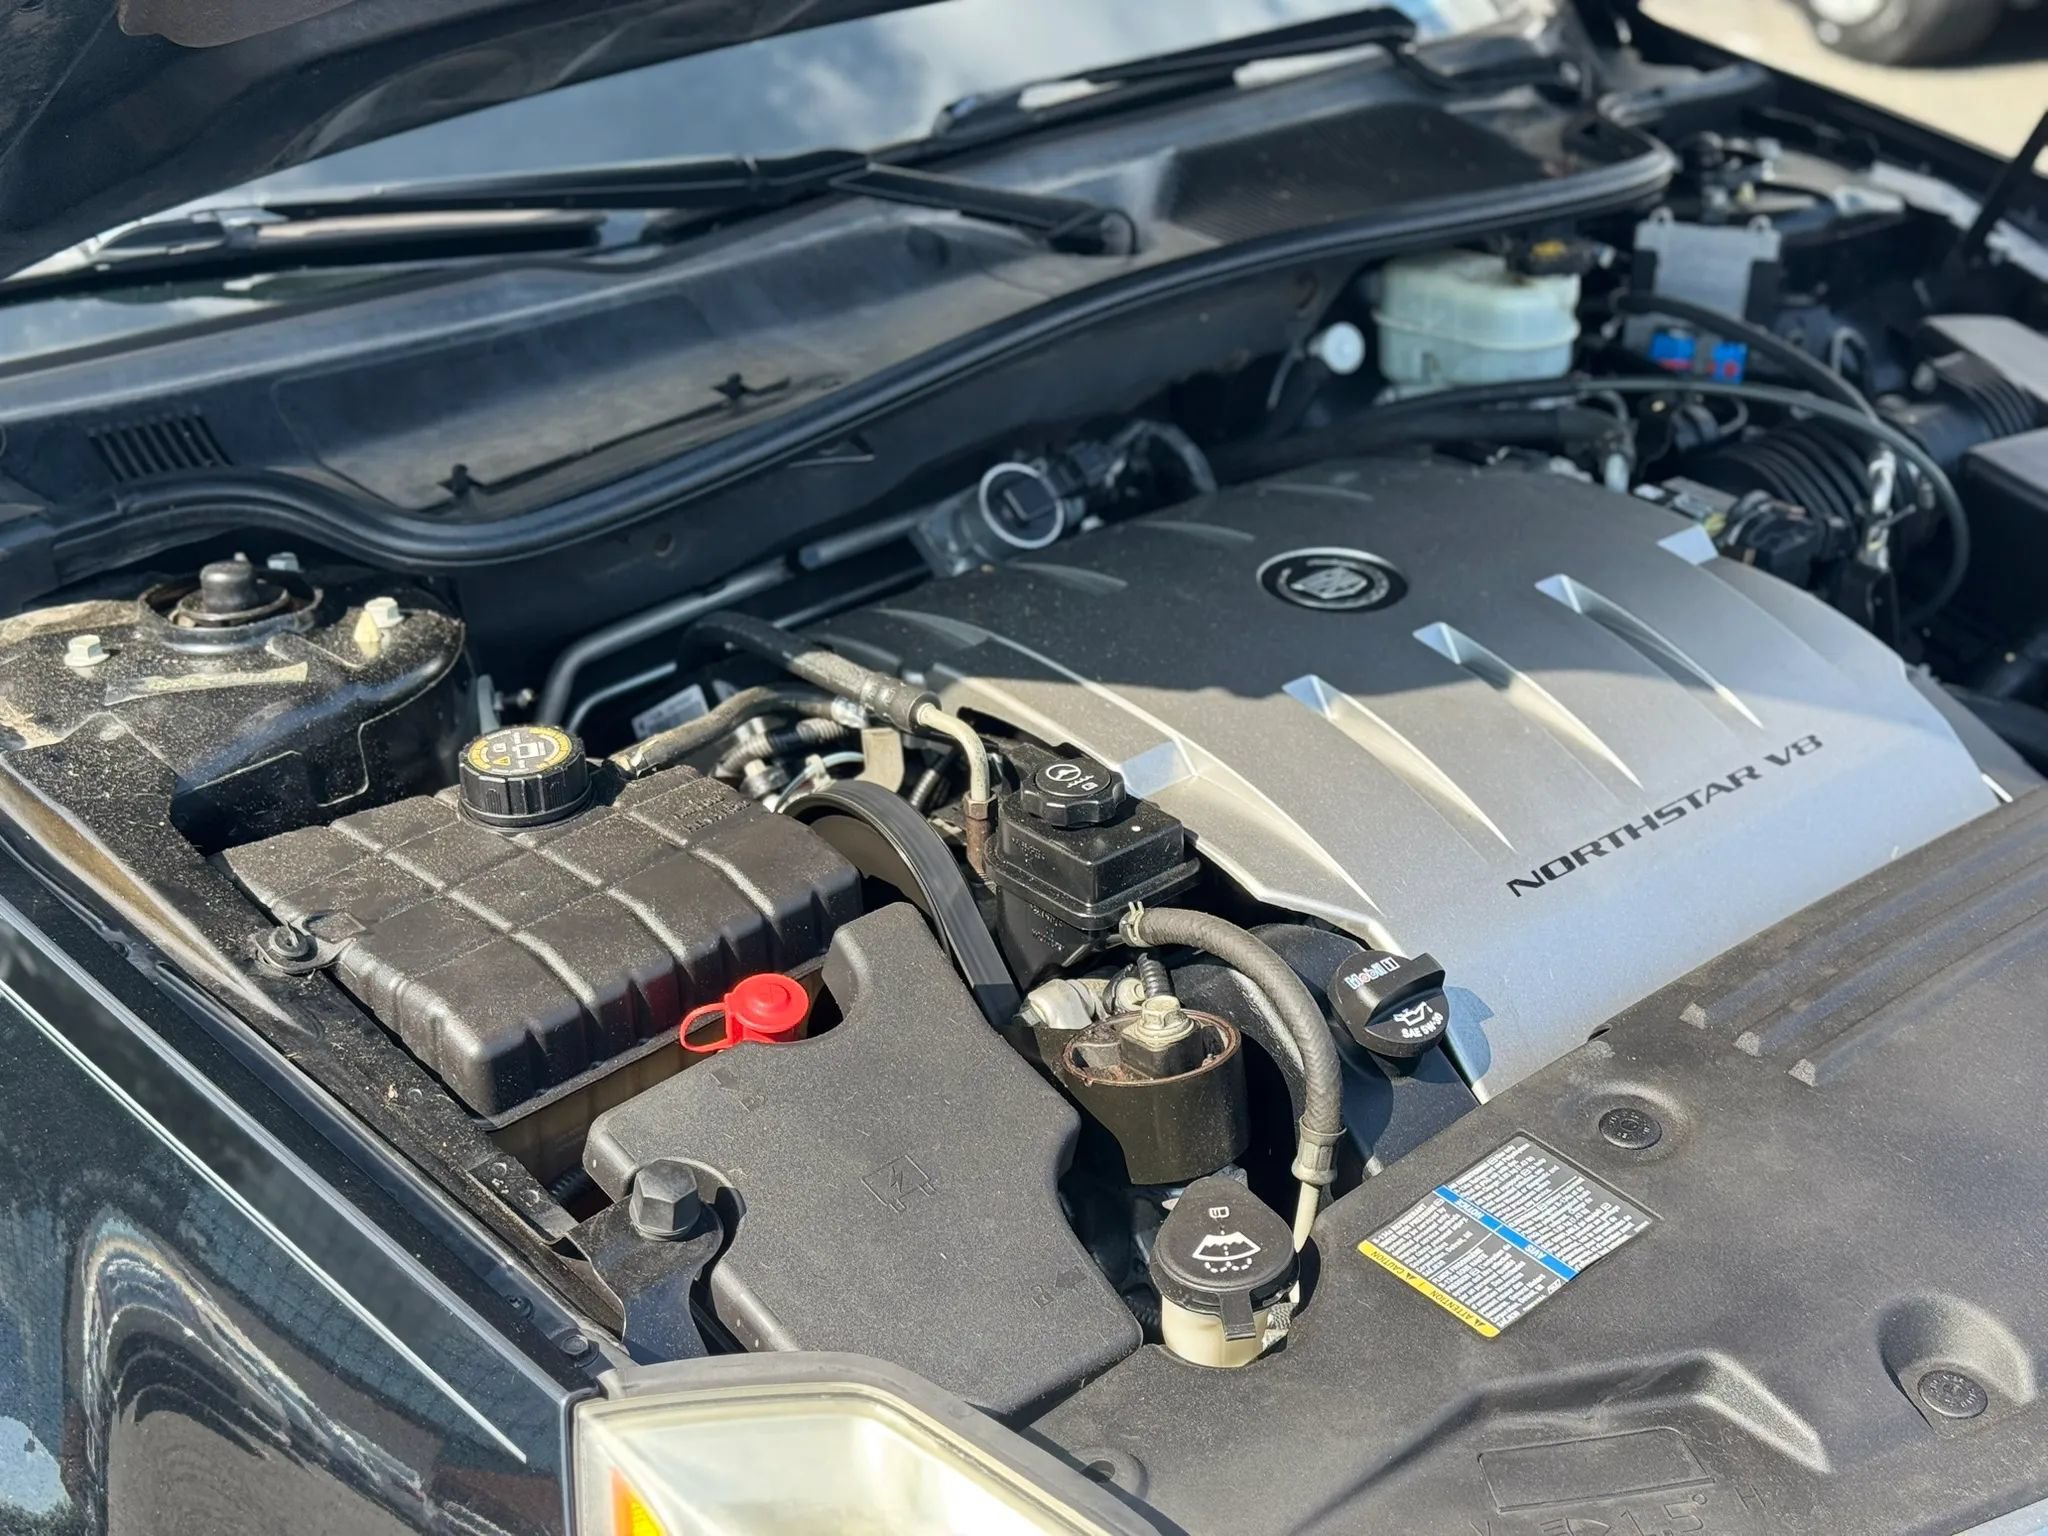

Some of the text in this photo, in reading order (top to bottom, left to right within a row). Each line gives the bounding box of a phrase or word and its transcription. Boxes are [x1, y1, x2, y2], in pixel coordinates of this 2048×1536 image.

[1505, 734, 1824, 898] NORTHSTAR V8
[1344, 962, 1389, 990] Mobil
[1401, 1028, 1423, 1038] SAE
[1455, 1199, 1485, 1219] NOTICE
[1370, 1251, 1405, 1275] CAUTION
[1524, 1243, 1548, 1259] AVIS
[1429, 1290, 1475, 1320] ATTENTION
